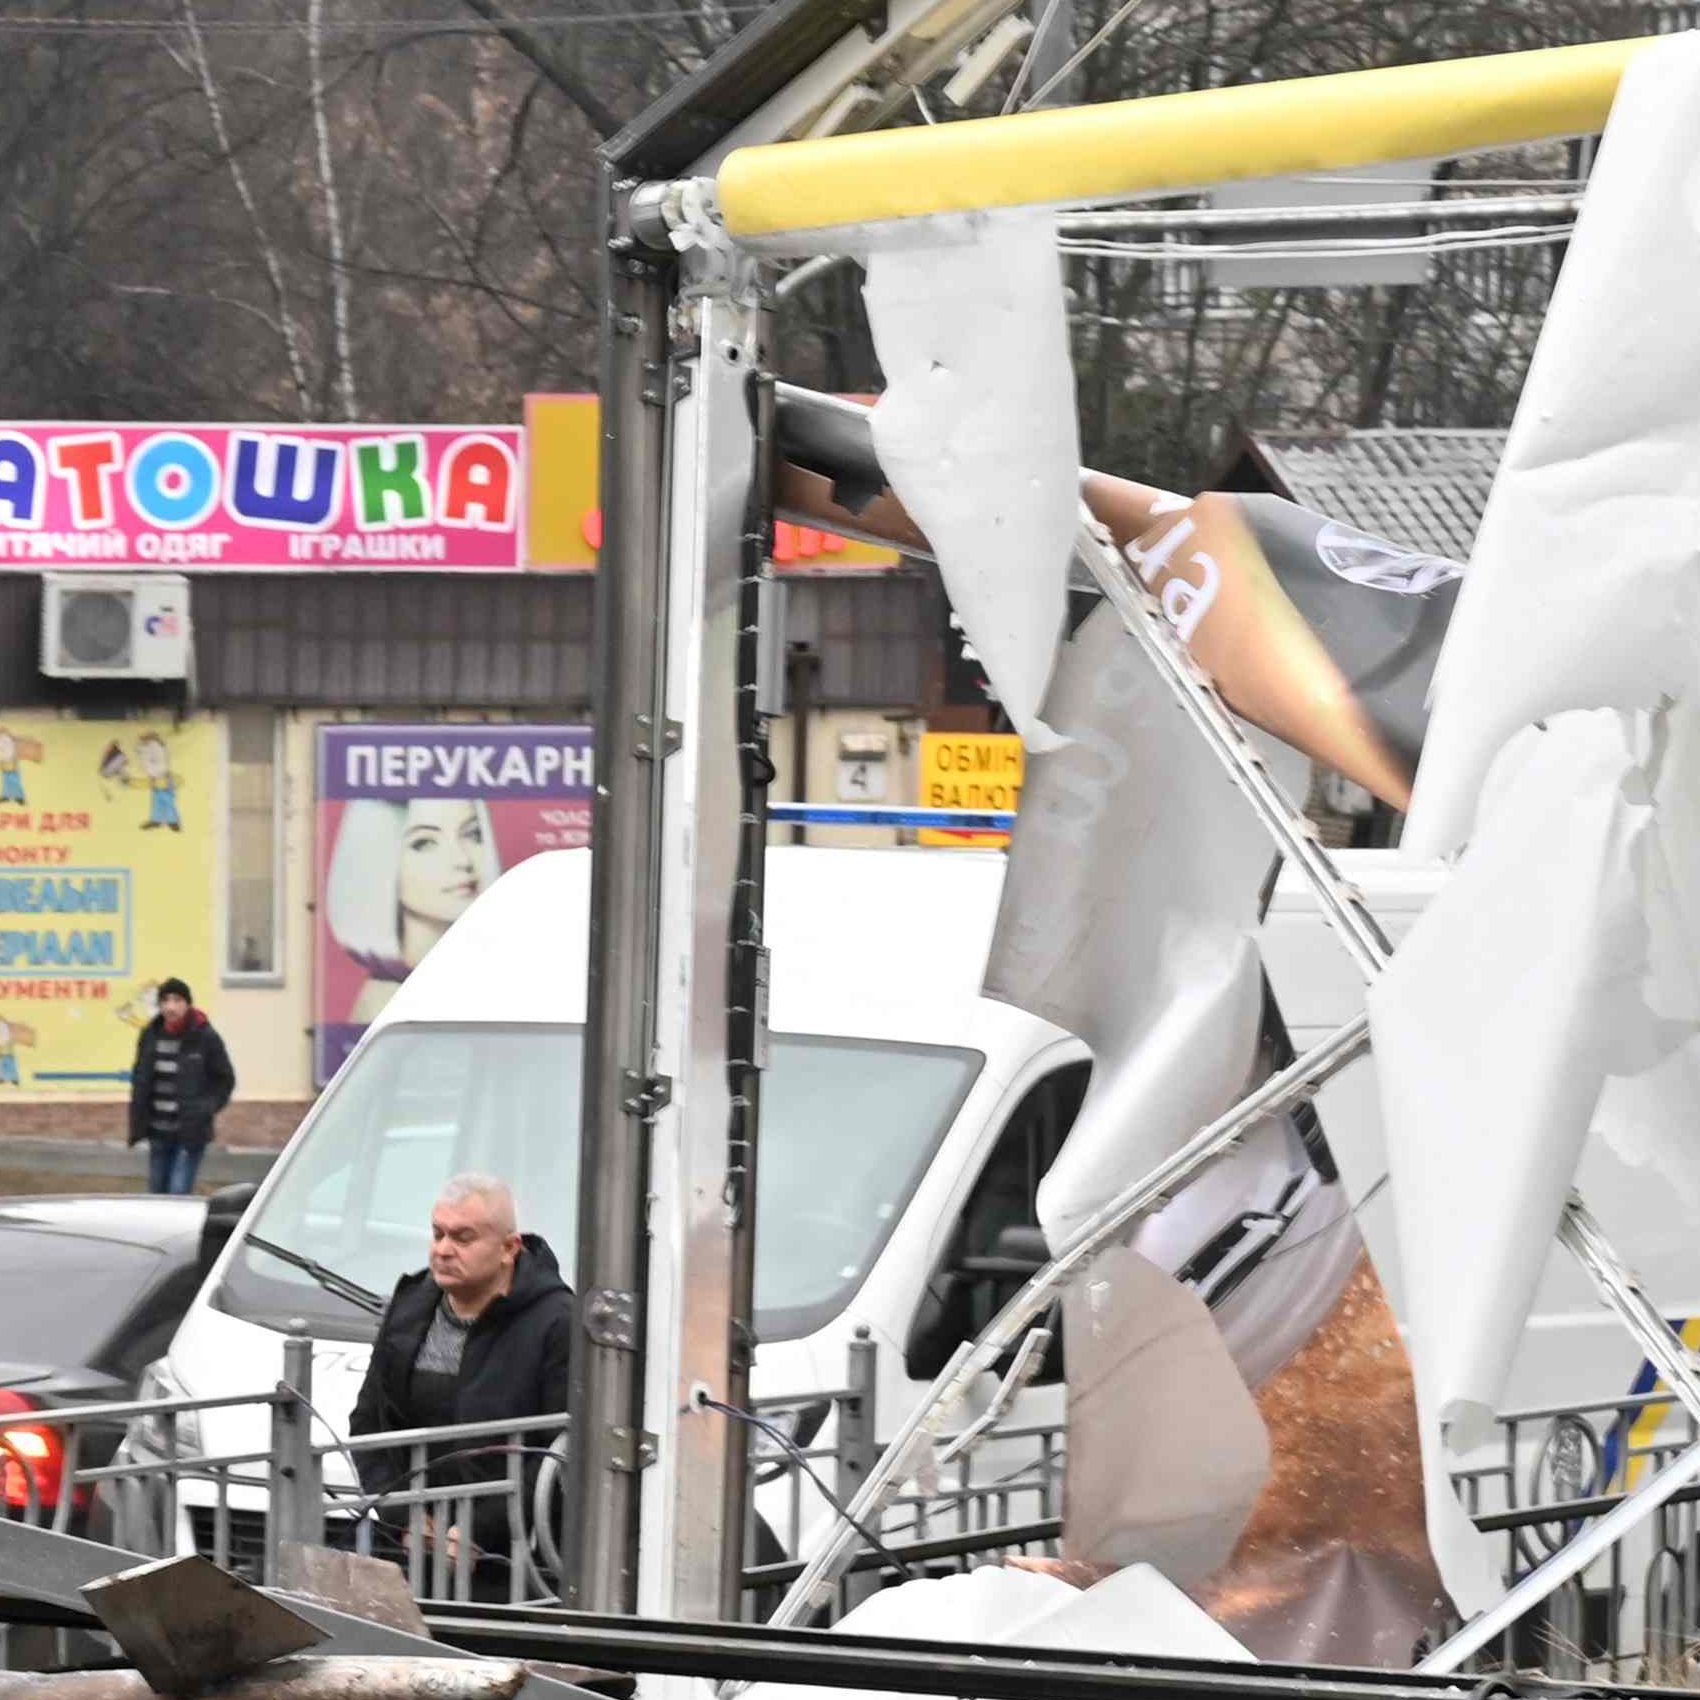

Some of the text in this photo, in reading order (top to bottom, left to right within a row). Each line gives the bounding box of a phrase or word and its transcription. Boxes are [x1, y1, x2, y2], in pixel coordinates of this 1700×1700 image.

[0, 431, 517, 530] АТОШКА
[136, 532, 232, 564] ОДЯГ
[288, 533, 446, 560] ІГРАШКИ
[346, 745, 594, 787] ПЕРУКАРН
[936, 743, 1019, 772] ОБМІН
